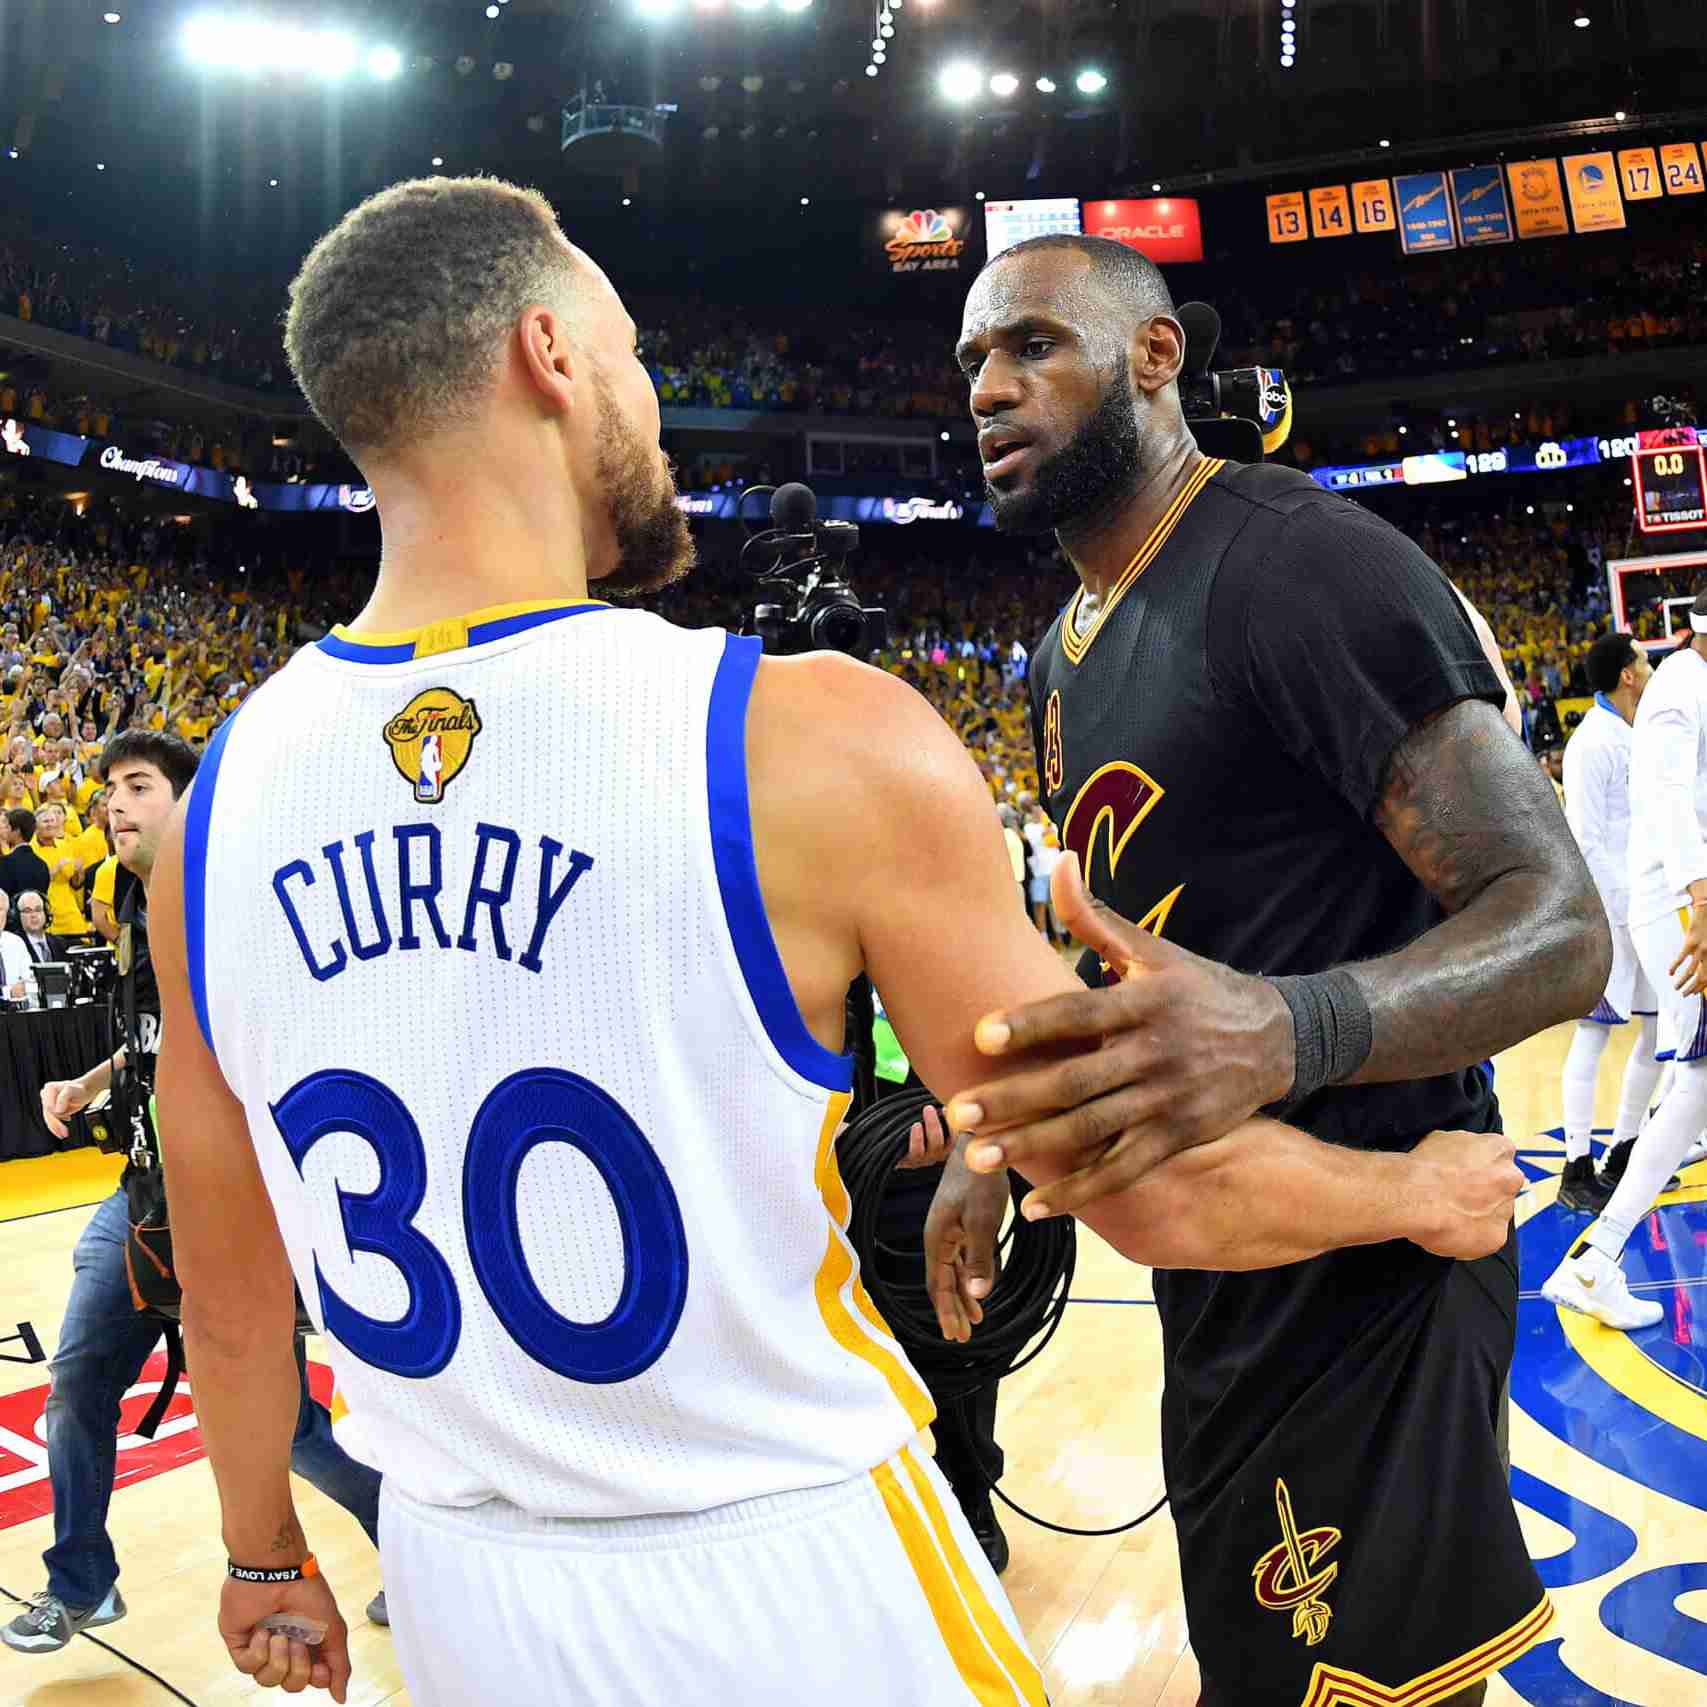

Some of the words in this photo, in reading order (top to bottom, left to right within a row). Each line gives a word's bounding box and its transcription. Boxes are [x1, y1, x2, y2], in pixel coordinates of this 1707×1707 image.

[1628, 167, 1649, 192] 17
[1667, 162, 1699, 187] 24
[1275, 211, 1300, 235] 13
[1319, 205, 1343, 229] 14
[1362, 200, 1386, 224] 16
[1098, 224, 1184, 239] ORACLE
[1264, 390, 1287, 403] abc
[1599, 437, 1637, 460] 120
[1466, 451, 1506, 474] 129
[1654, 453, 1684, 476] 0.0
[415, 705, 474, 738] Finals
[272, 822, 594, 982] CURRY
[268, 1067, 689, 1384] 30
[235, 1568, 265, 1581] LOVE
[267, 1571, 290, 1581] SAY
